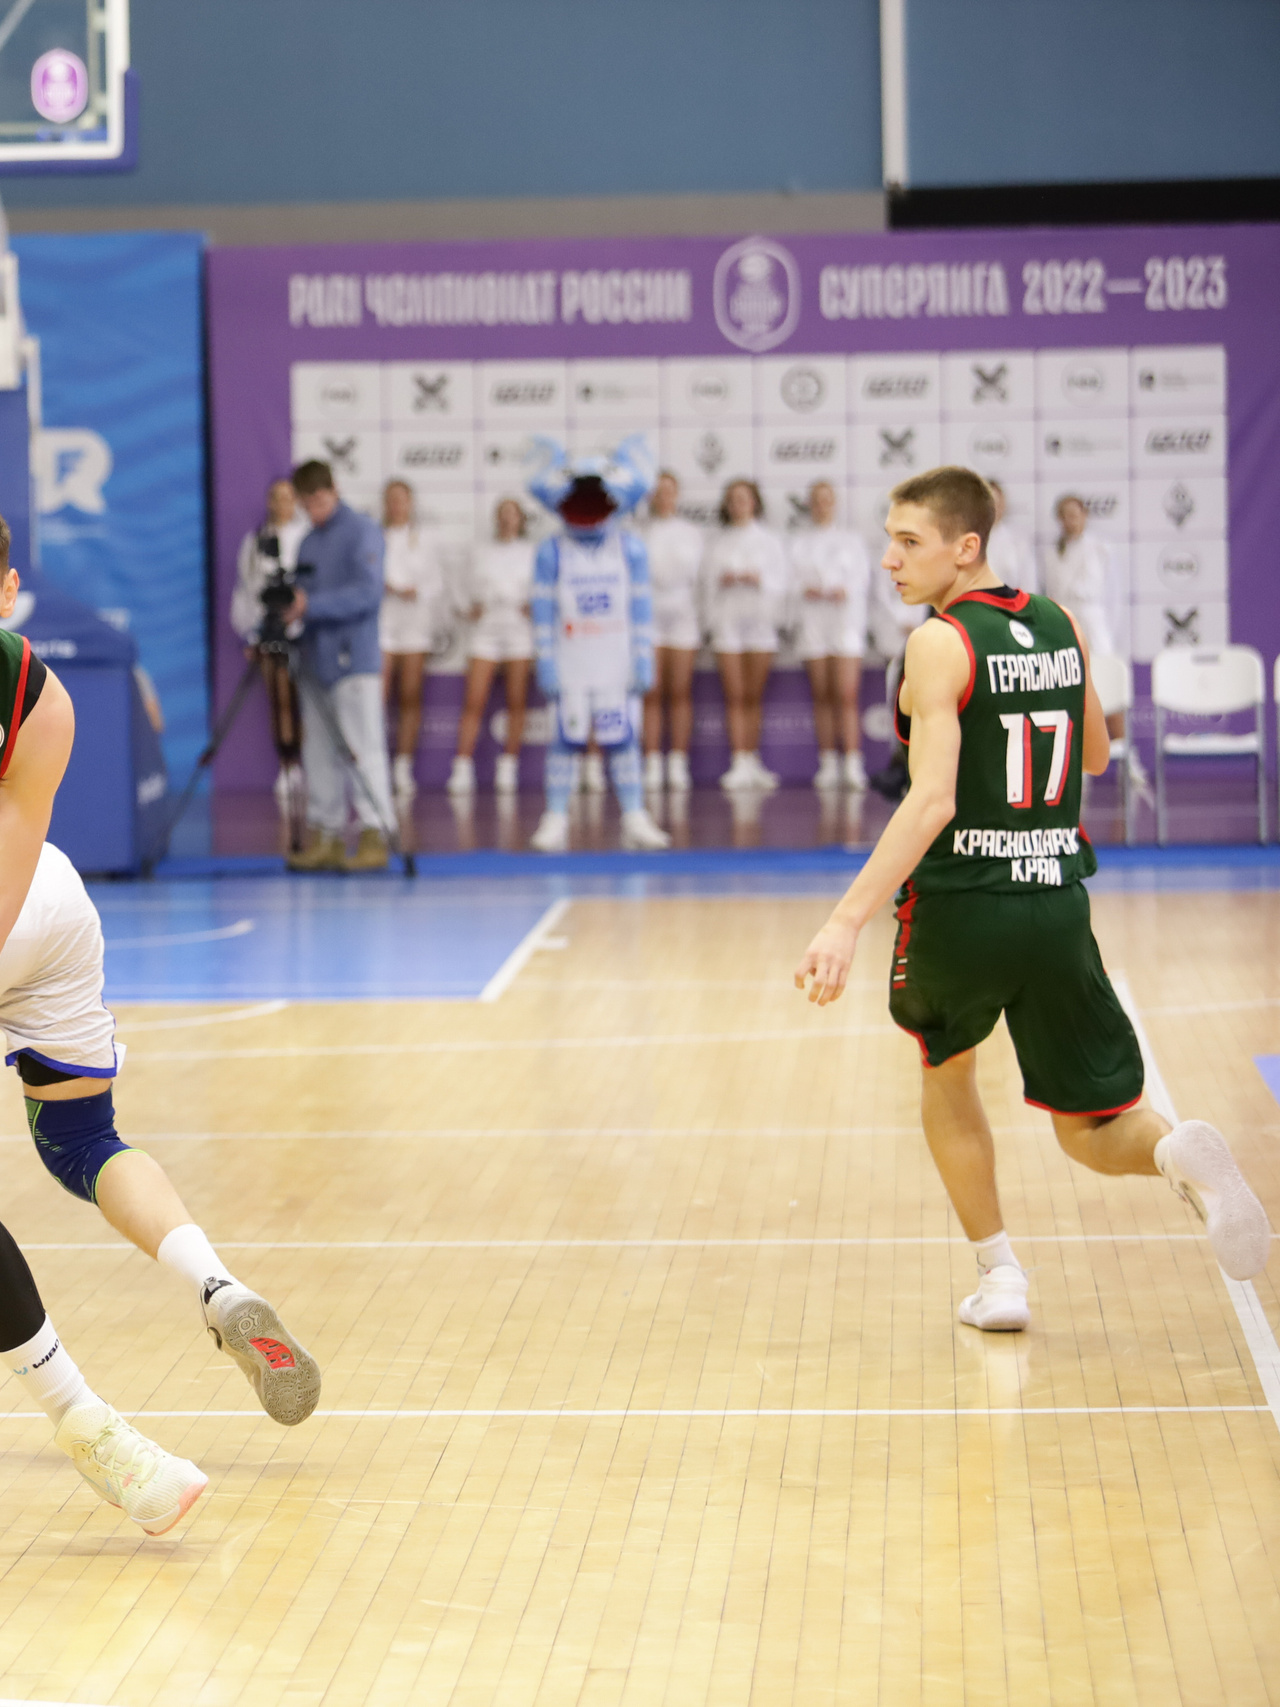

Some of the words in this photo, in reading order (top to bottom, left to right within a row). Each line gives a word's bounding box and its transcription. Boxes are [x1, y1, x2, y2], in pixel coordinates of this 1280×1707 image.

[561, 268, 692, 325] РОССИИ
[819, 261, 1010, 320] СУПЕРЛИГА
[987, 647, 1082, 693] ГЕРАСИМОВ
[999, 709, 1074, 808] 17
[953, 827, 1080, 858] КРАСНОДАРСК
